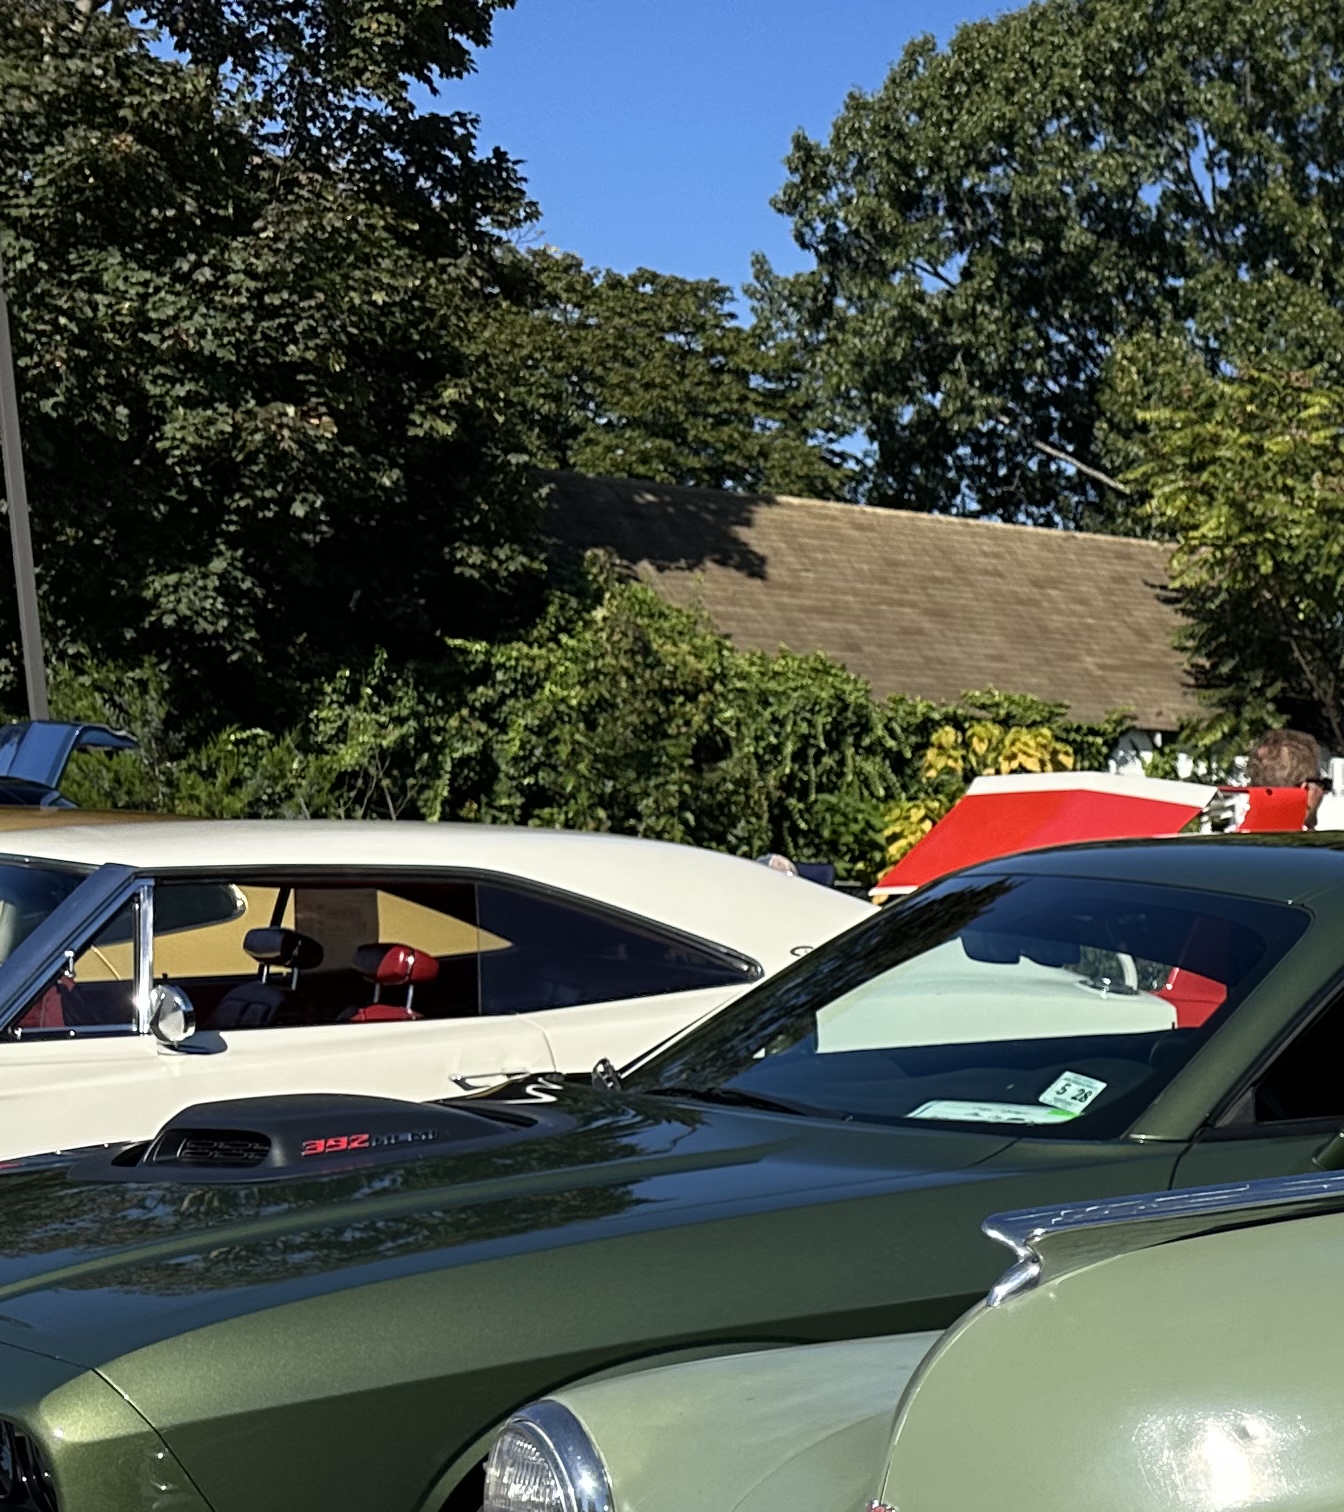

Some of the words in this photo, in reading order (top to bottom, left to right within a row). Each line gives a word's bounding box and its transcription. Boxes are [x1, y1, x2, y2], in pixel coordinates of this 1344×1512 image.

[1056, 1082, 1071, 1095] 5
[1070, 1088, 1093, 1103] 28
[300, 1132, 369, 1156] 392
